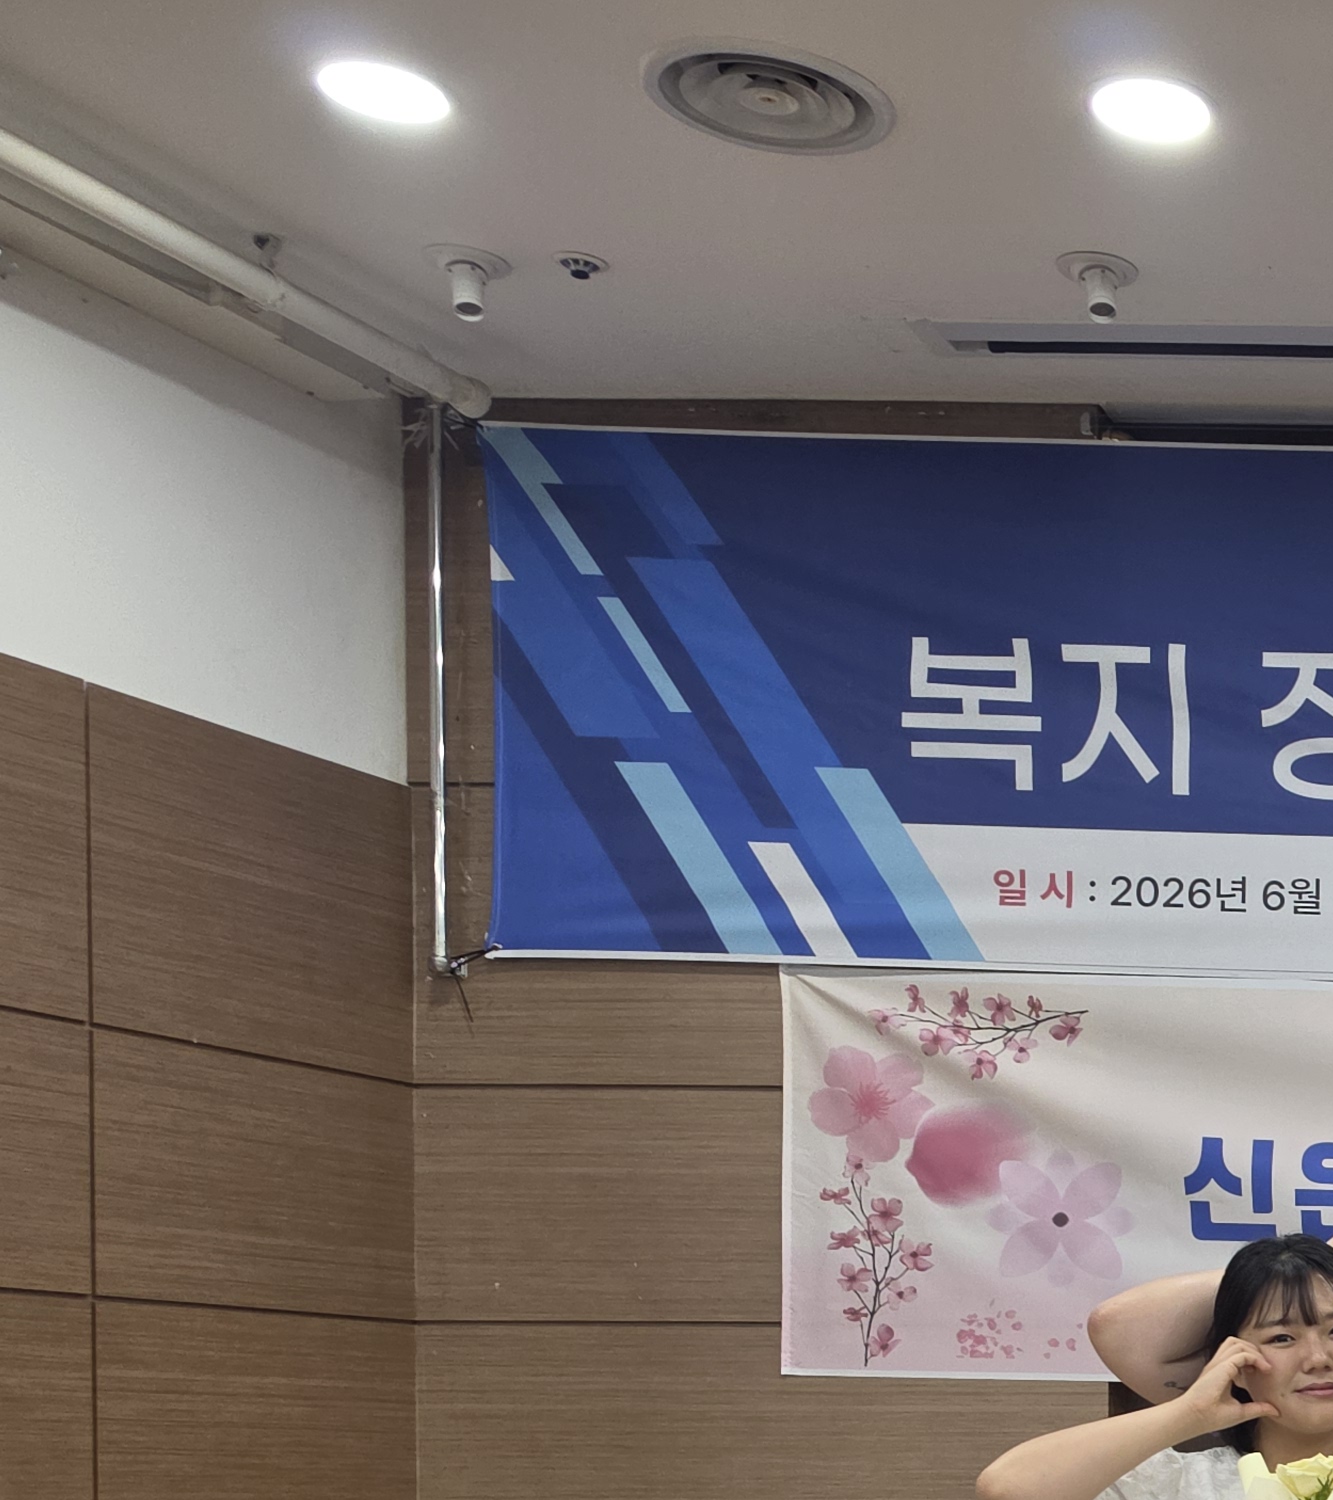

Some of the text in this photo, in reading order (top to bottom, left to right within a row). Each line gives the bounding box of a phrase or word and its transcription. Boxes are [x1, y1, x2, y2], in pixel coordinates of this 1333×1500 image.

[901, 636, 1190, 796] 복지
[1110, 875, 1247, 913] 2026년
[1262, 877, 1322, 916] 6월
